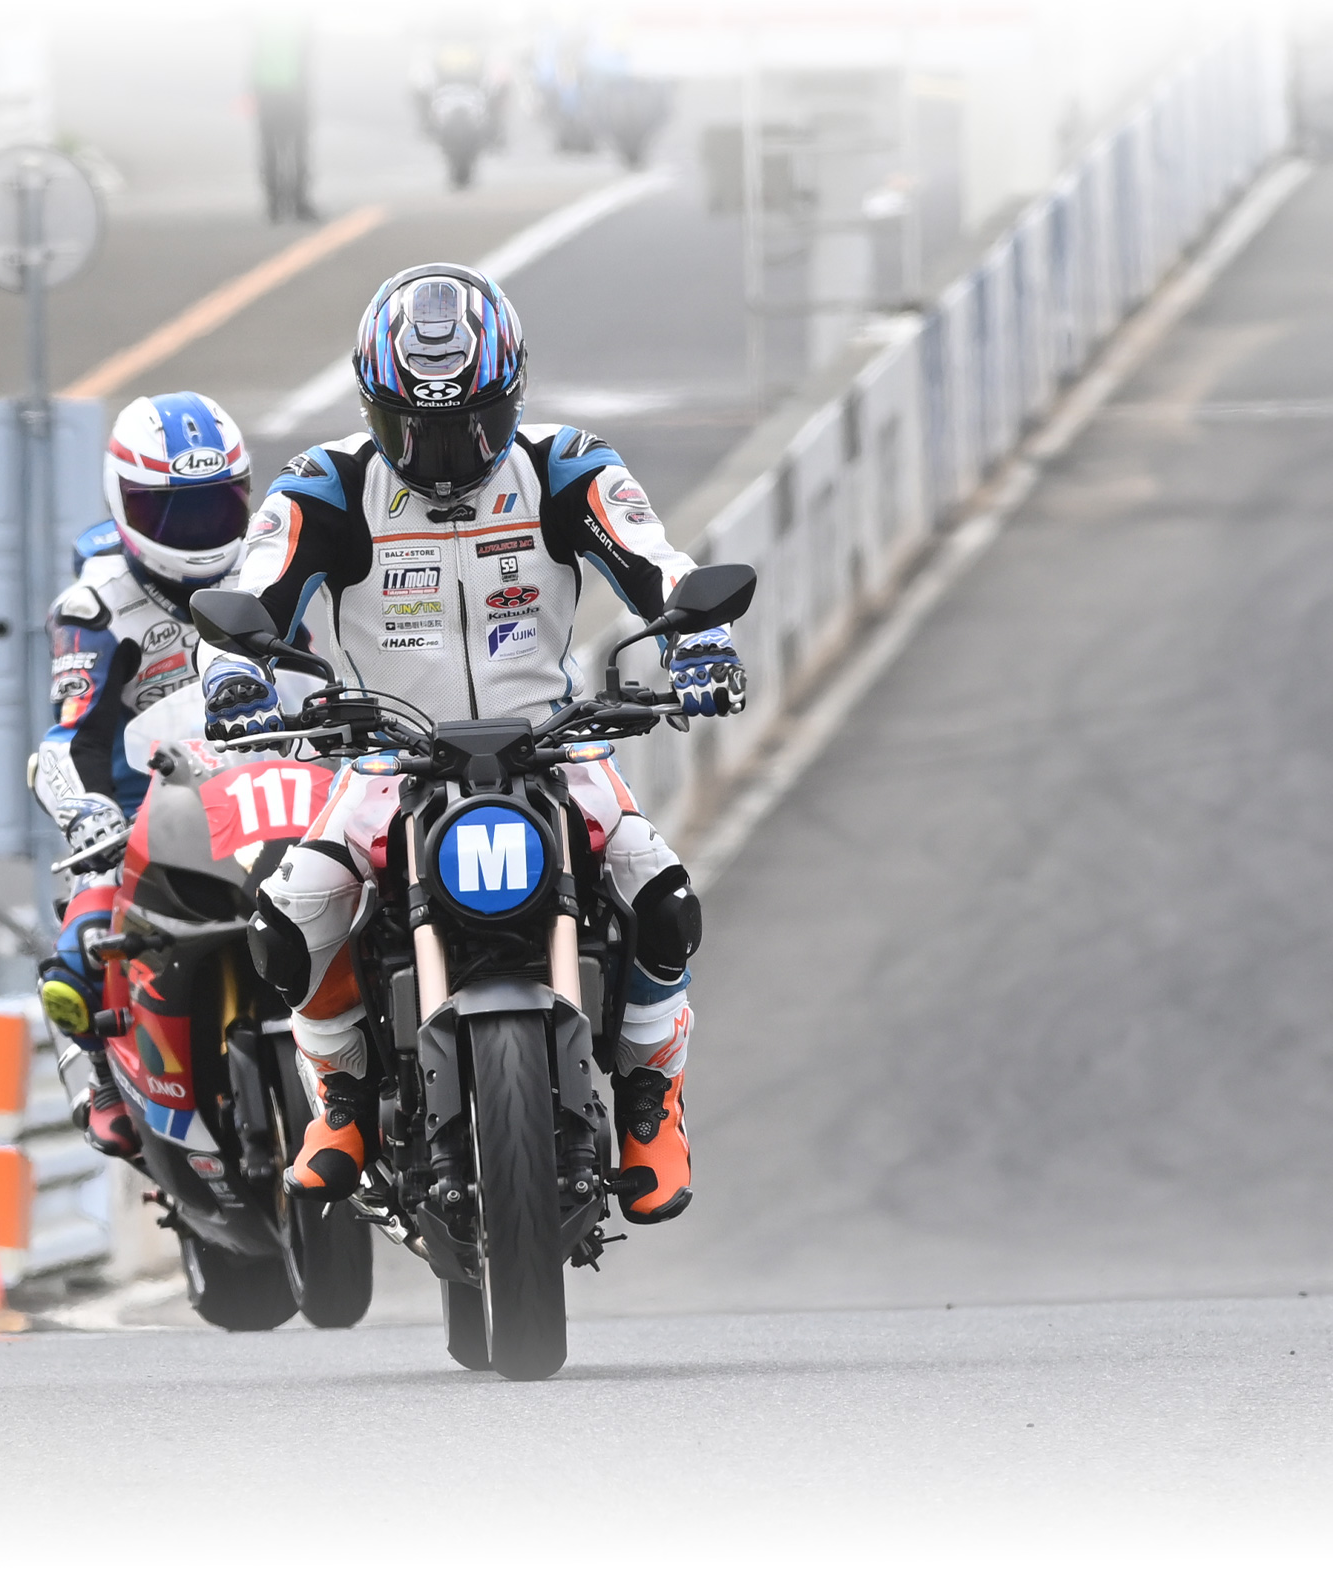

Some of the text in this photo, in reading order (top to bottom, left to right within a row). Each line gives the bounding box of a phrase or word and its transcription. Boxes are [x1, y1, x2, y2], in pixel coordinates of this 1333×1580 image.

[416, 400, 461, 408] Kabuto
[478, 539, 533, 554] ADVANCE MC
[501, 558, 517, 573] 59
[384, 601, 443, 616] SUNSTAR
[488, 607, 540, 620] Kabuto
[225, 768, 313, 835] 117
[455, 822, 529, 893] M
